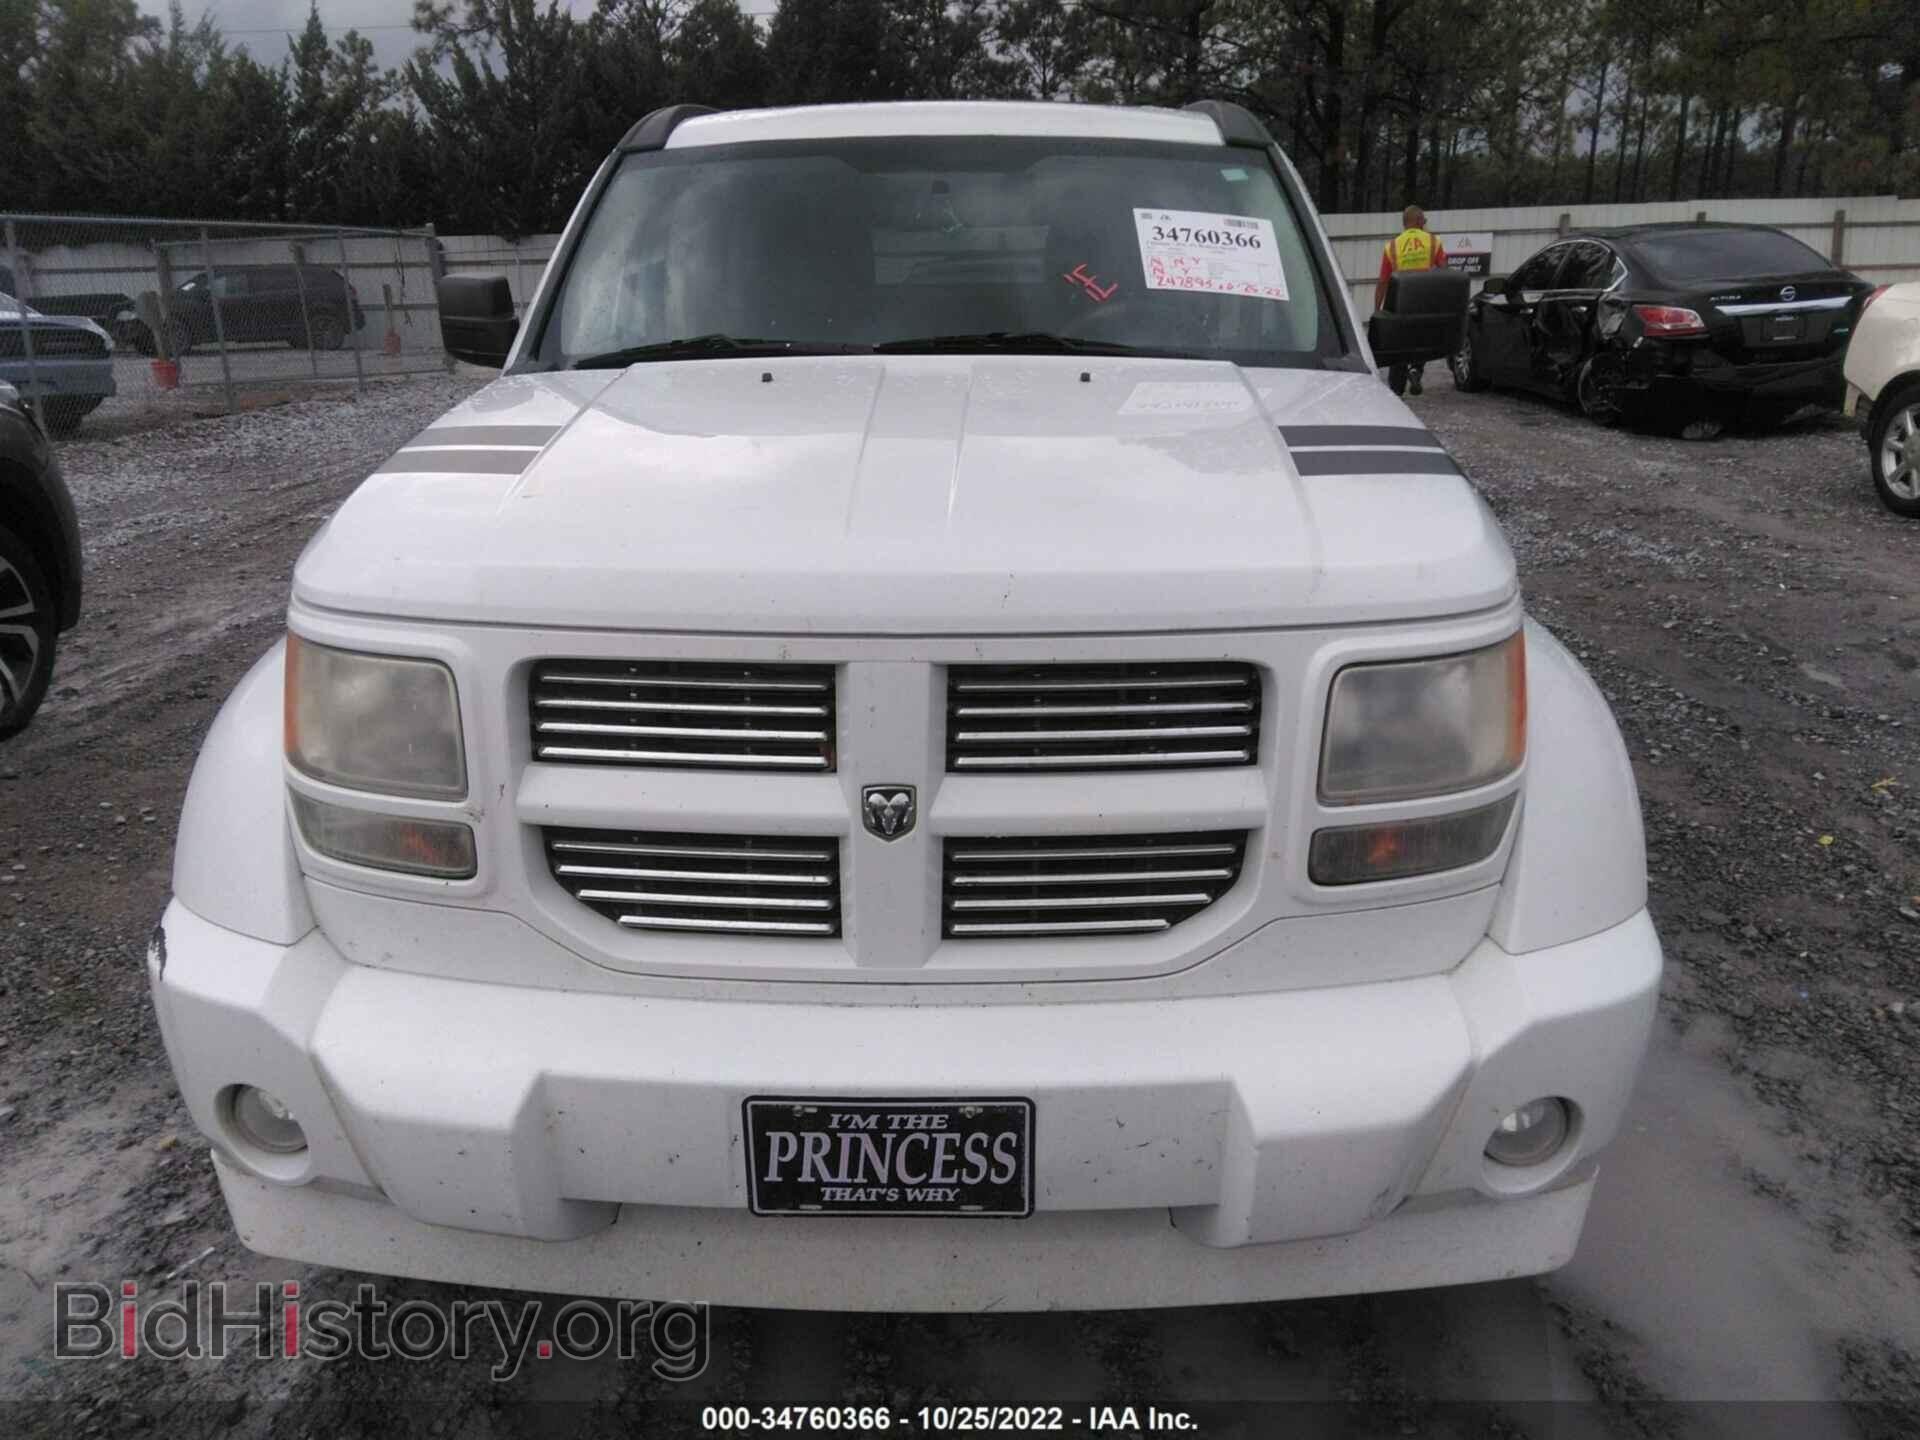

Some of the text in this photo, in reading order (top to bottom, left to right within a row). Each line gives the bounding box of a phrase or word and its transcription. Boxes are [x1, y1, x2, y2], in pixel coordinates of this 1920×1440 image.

[1152, 225, 1262, 249] 34760366
[828, 1113, 950, 1129] I'M THE
[764, 1131, 1019, 1185] PRINCESS
[820, 1187, 961, 1202] THAT'S WHY
